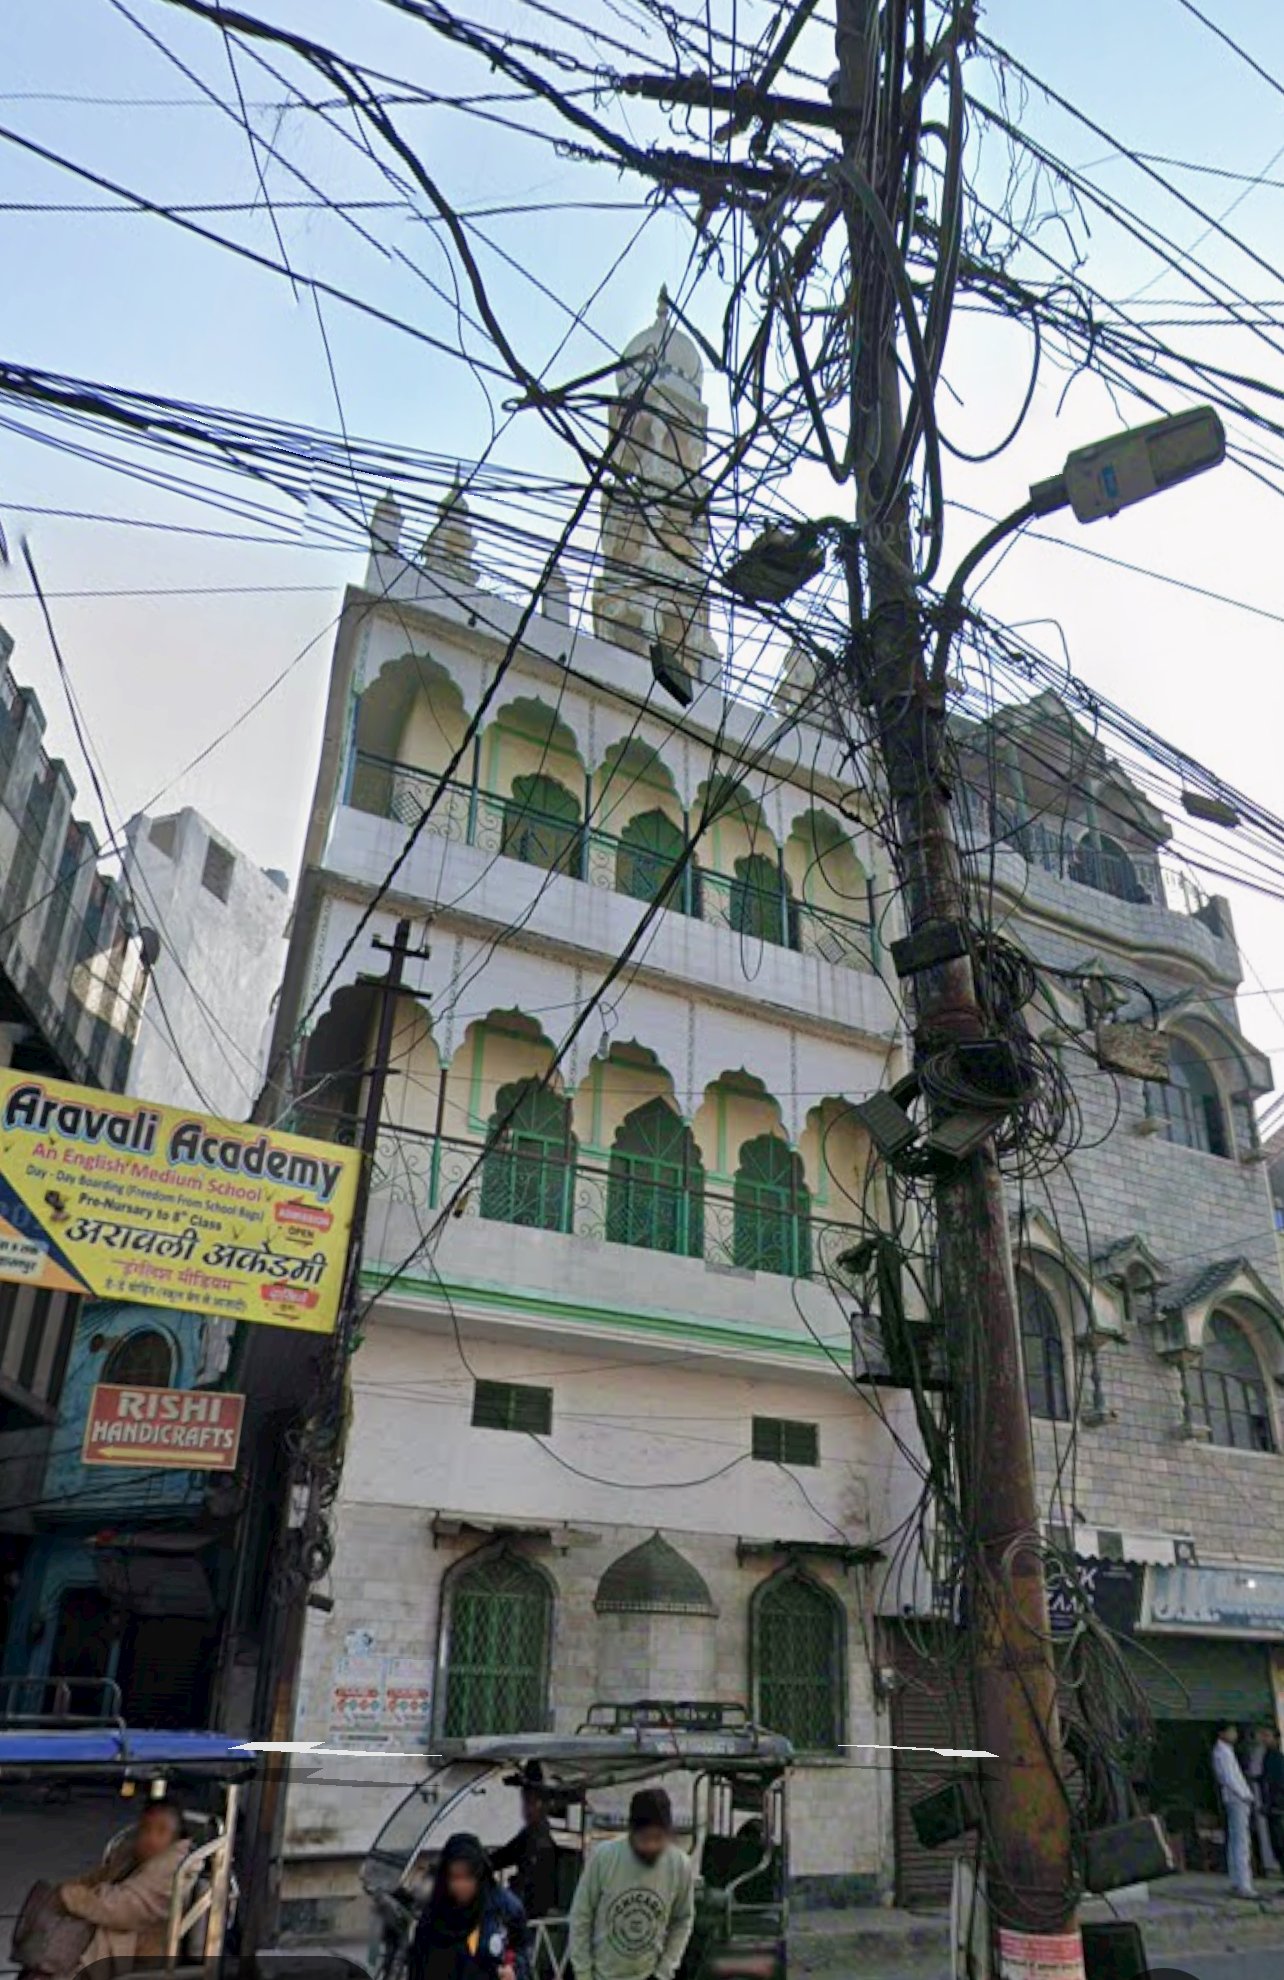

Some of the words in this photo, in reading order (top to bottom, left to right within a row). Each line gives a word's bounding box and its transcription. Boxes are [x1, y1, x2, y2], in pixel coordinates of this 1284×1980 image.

[4, 1083, 160, 1154] Aravali
[168, 1121, 344, 1200] Academy
[25, 1164, 47, 1179] Day
[56, 1169, 76, 1184] Day
[32, 1142, 58, 1161] An
[62, 1147, 126, 1175] English
[130, 1162, 202, 1190] Medium
[206, 1179, 263, 1202] School
[157, 1208, 170, 1220] to
[189, 1213, 223, 1232] Class
[287, 1225, 315, 1240] OPEN
[65, 1216, 200, 1262] अरावली
[117, 1391, 221, 1423] RISHI
[90, 1420, 235, 1449] HANDICRAFTS
